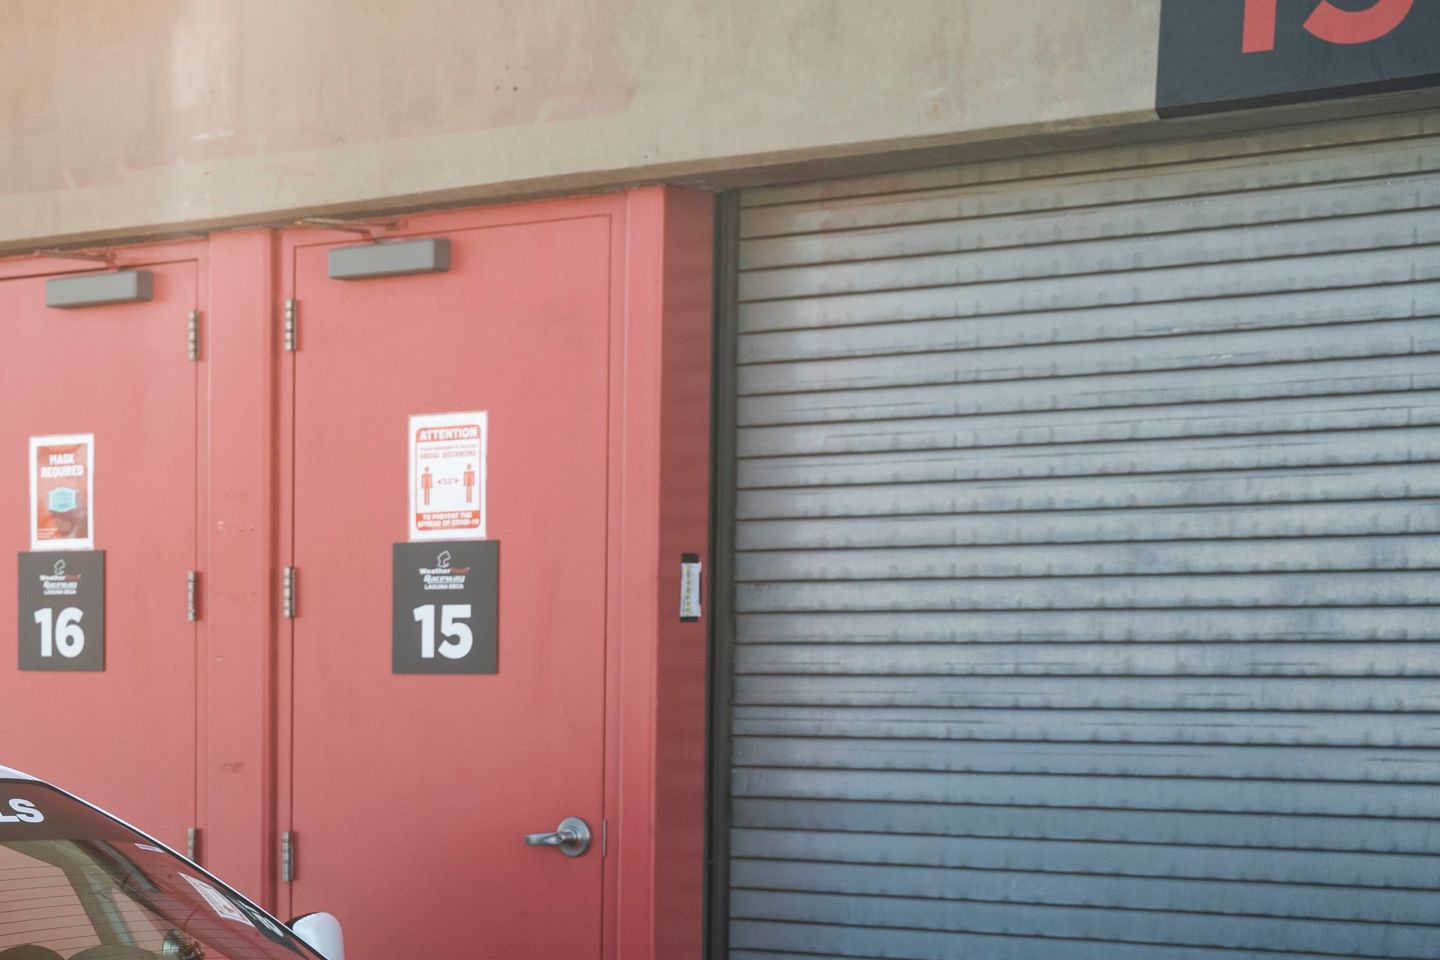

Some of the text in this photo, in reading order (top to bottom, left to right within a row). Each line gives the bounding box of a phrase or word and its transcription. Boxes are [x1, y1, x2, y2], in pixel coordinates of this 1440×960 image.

[419, 426, 479, 441] ATTENTION
[48, 452, 76, 466] MASK
[33, 606, 86, 659] 16
[412, 604, 474, 660] 15
